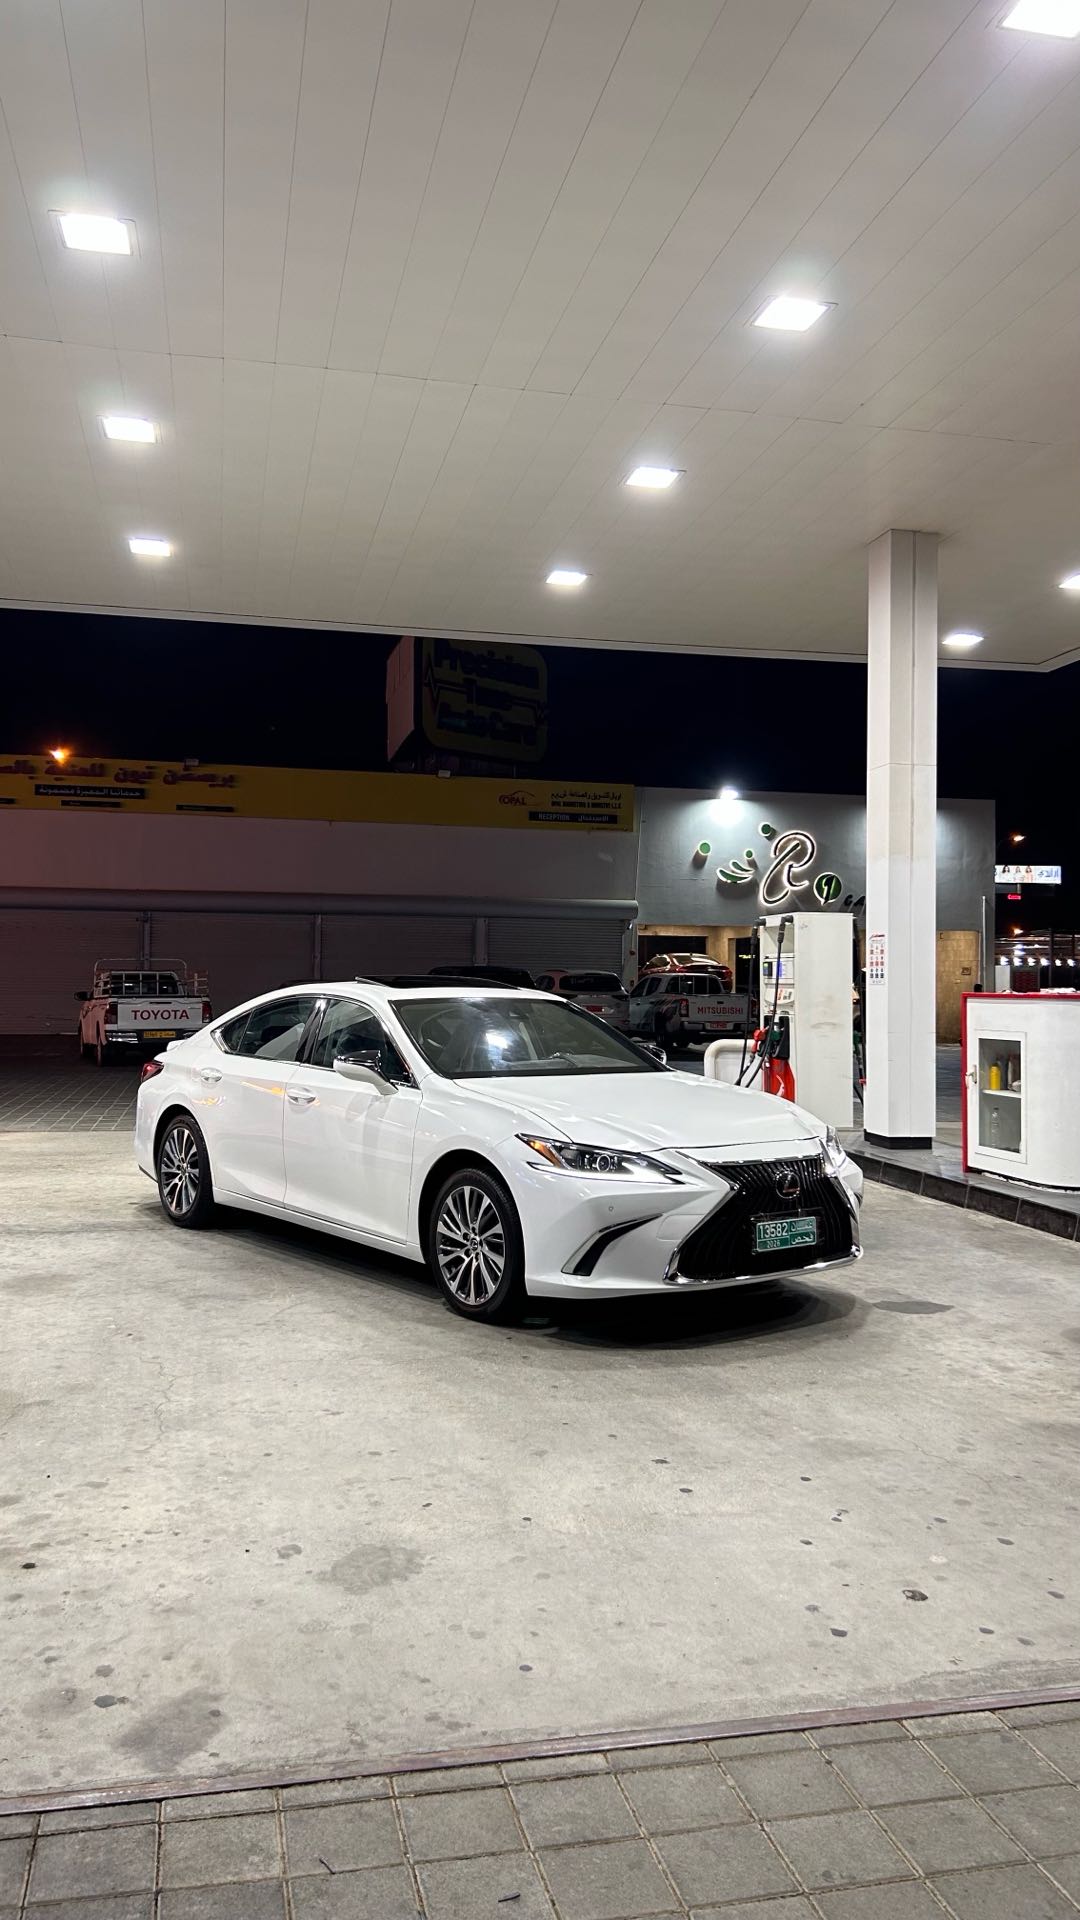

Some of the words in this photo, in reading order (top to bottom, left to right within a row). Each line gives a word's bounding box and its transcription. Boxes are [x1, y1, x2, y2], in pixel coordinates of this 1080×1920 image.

[538, 812, 570, 821] RECEPTION
[131, 1010, 190, 1020] TOYOTA
[697, 1006, 743, 1015] MITSUBISHI
[760, 1223, 788, 1239] 13582
[791, 1233, 814, 1245] فحص
